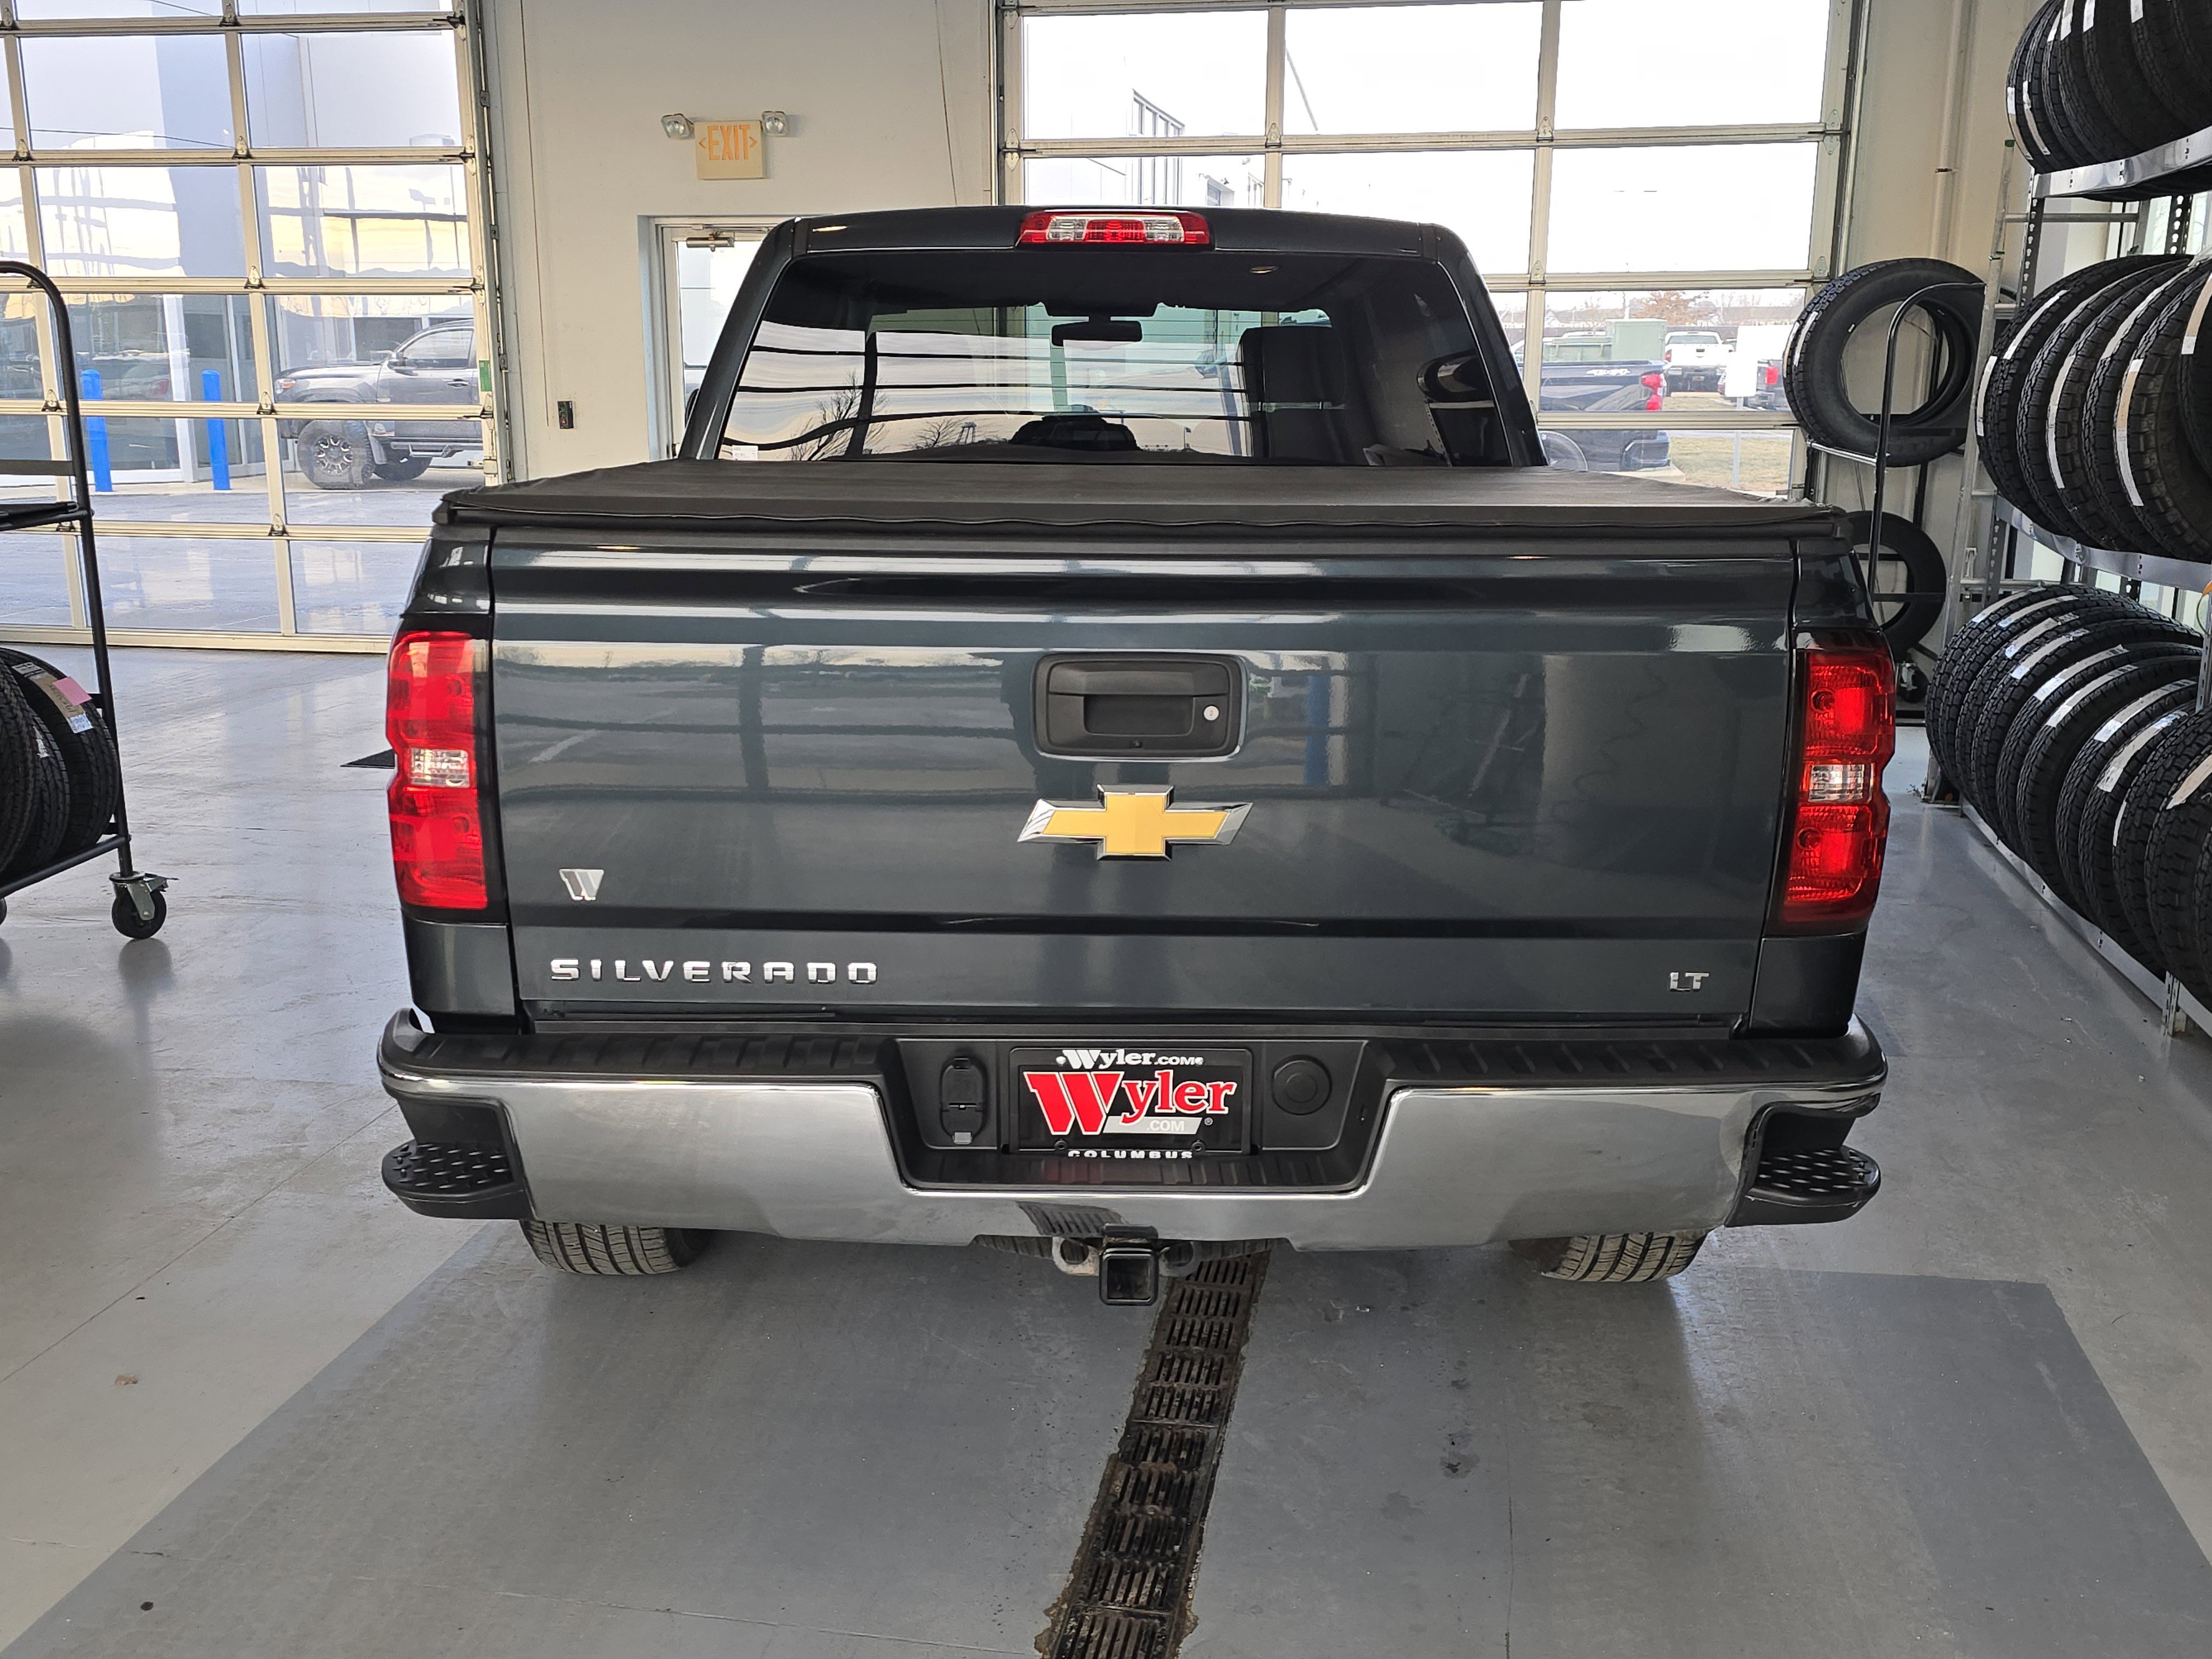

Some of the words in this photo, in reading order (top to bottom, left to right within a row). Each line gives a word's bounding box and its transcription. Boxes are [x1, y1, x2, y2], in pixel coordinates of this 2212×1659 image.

[707, 124, 750, 160] EXIT
[550, 958, 878, 983] SILVERADO
[1670, 972, 1710, 991] LT
[1023, 1070, 1237, 1135] Wyler
[1068, 1150, 1193, 1159] COLUMBUS
